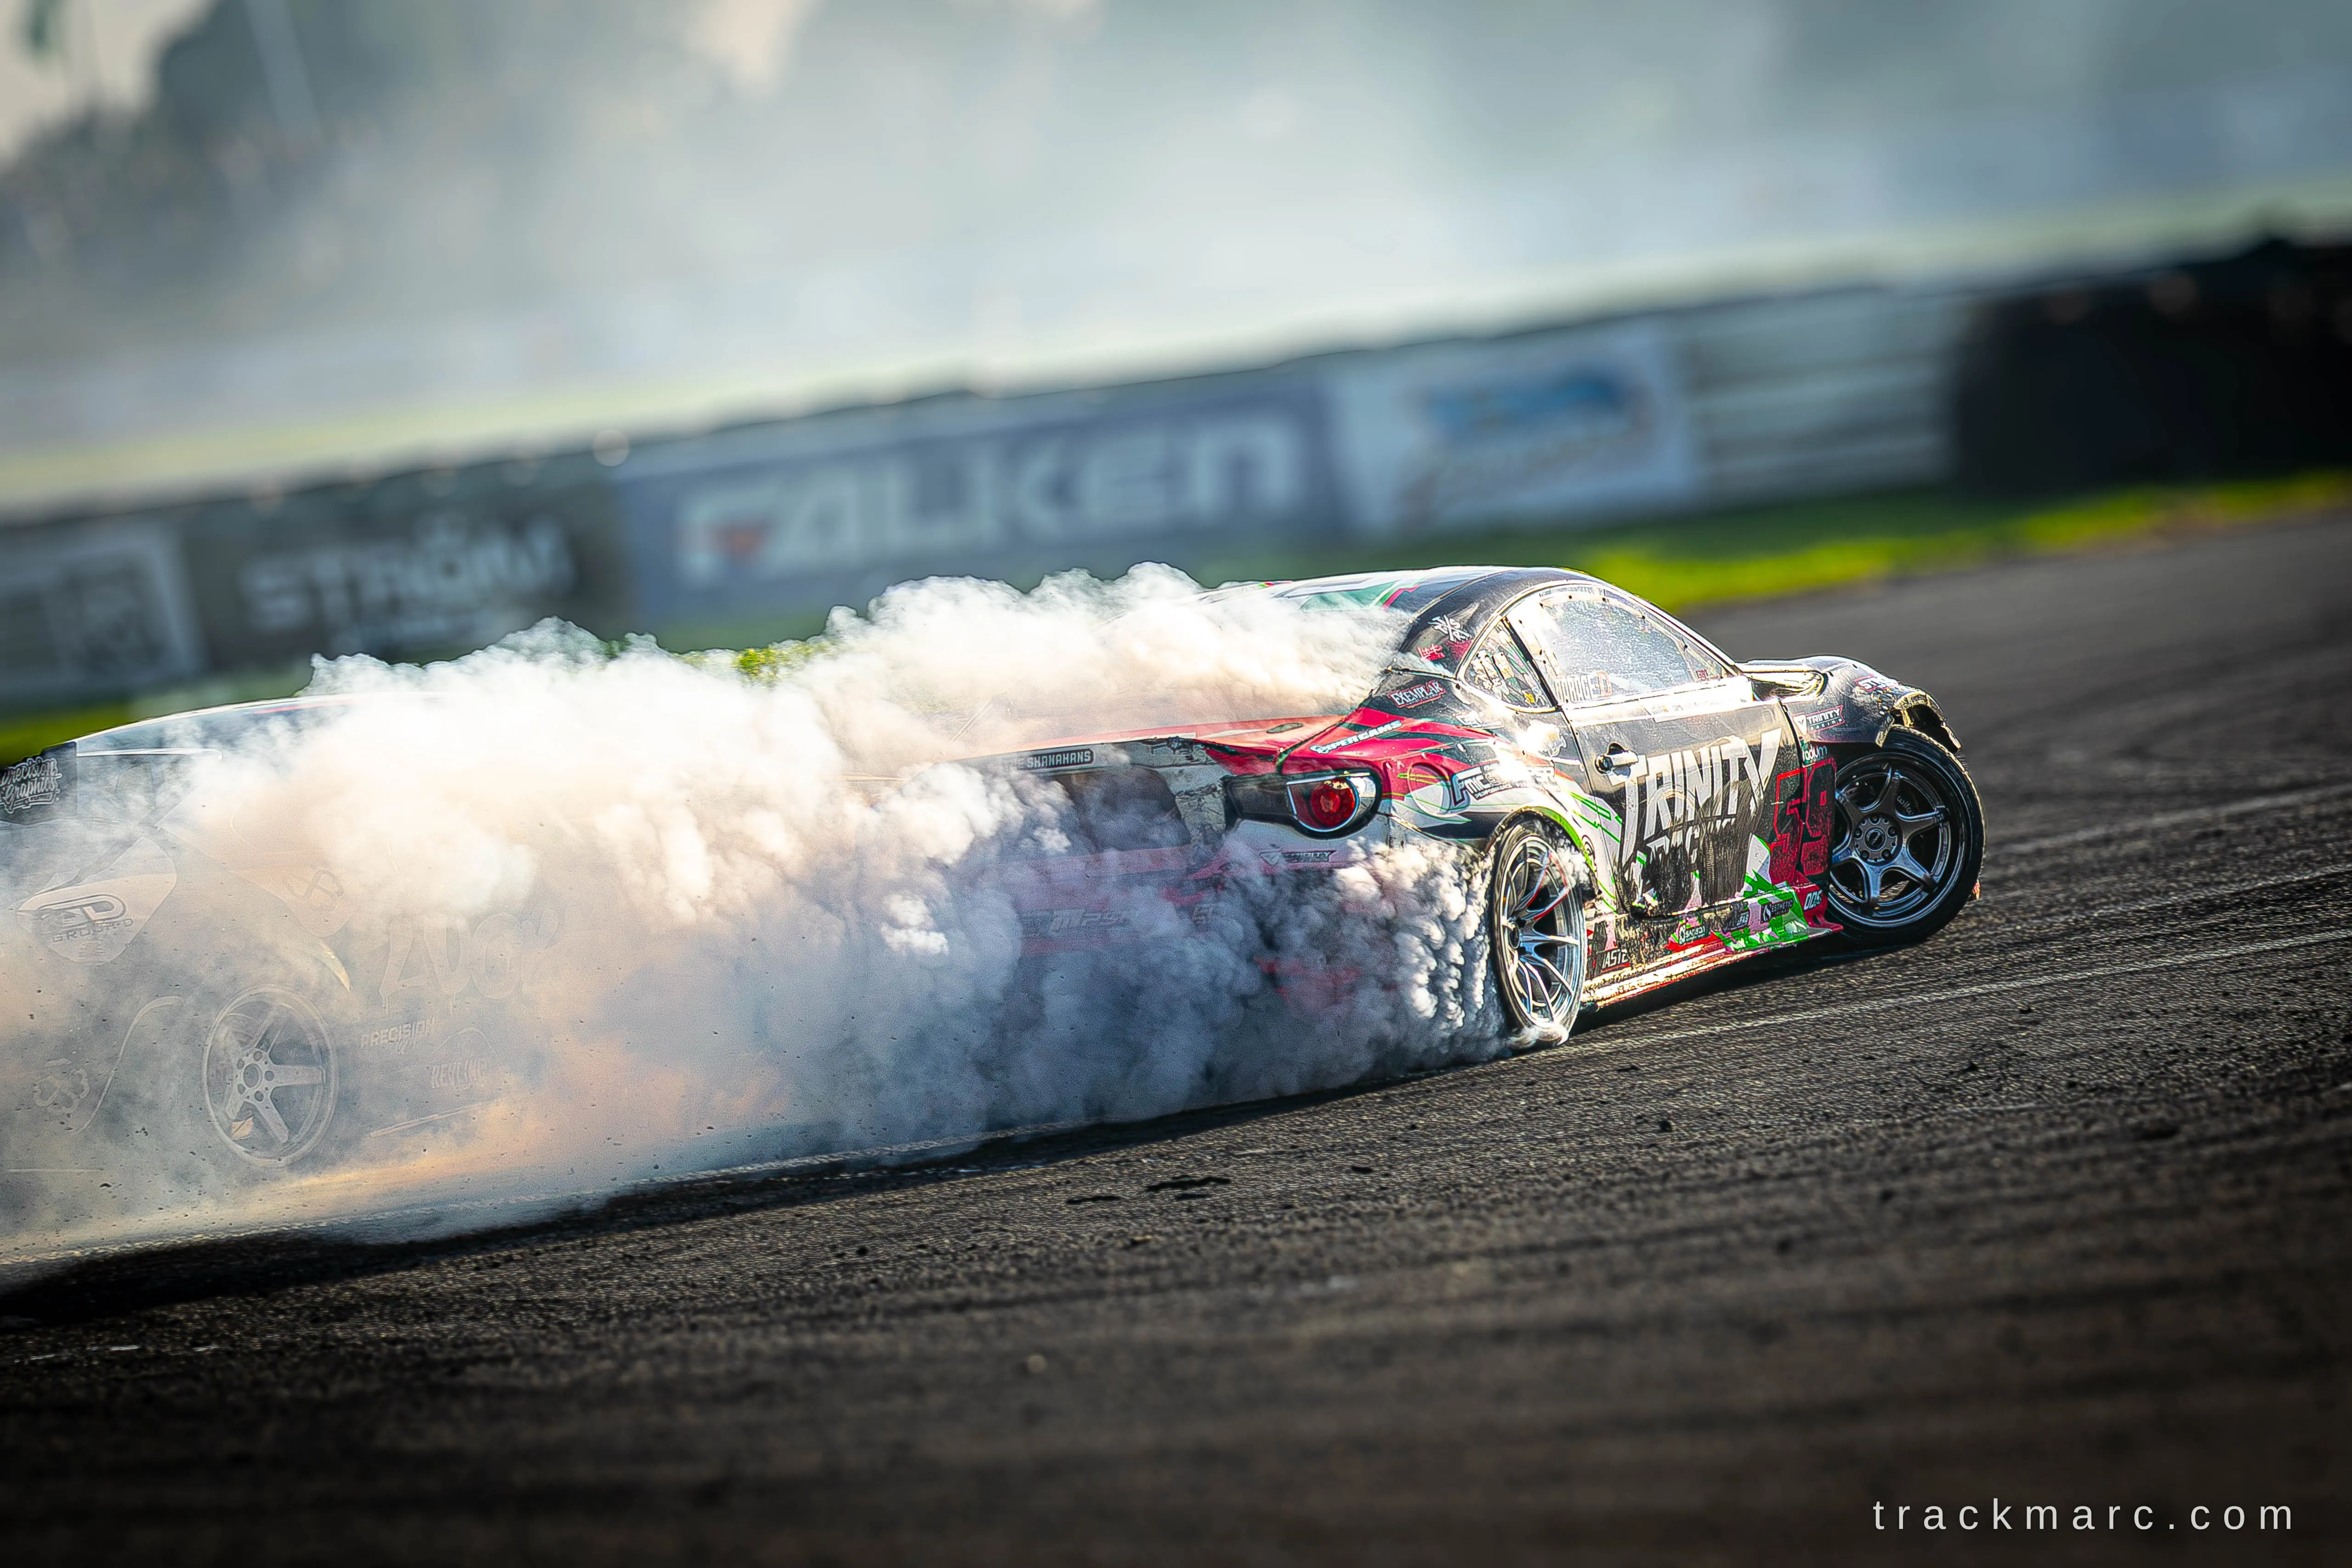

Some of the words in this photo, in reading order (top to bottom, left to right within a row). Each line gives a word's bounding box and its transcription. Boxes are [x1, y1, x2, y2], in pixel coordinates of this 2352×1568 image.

[676, 414, 1307, 584] FALKEN
[1391, 681, 1443, 705] EXEMPLAR
[1807, 708, 1840, 724] TRINITY
[1027, 750, 1091, 769] SHANAHANS
[1610, 727, 1782, 869] TRINITY
